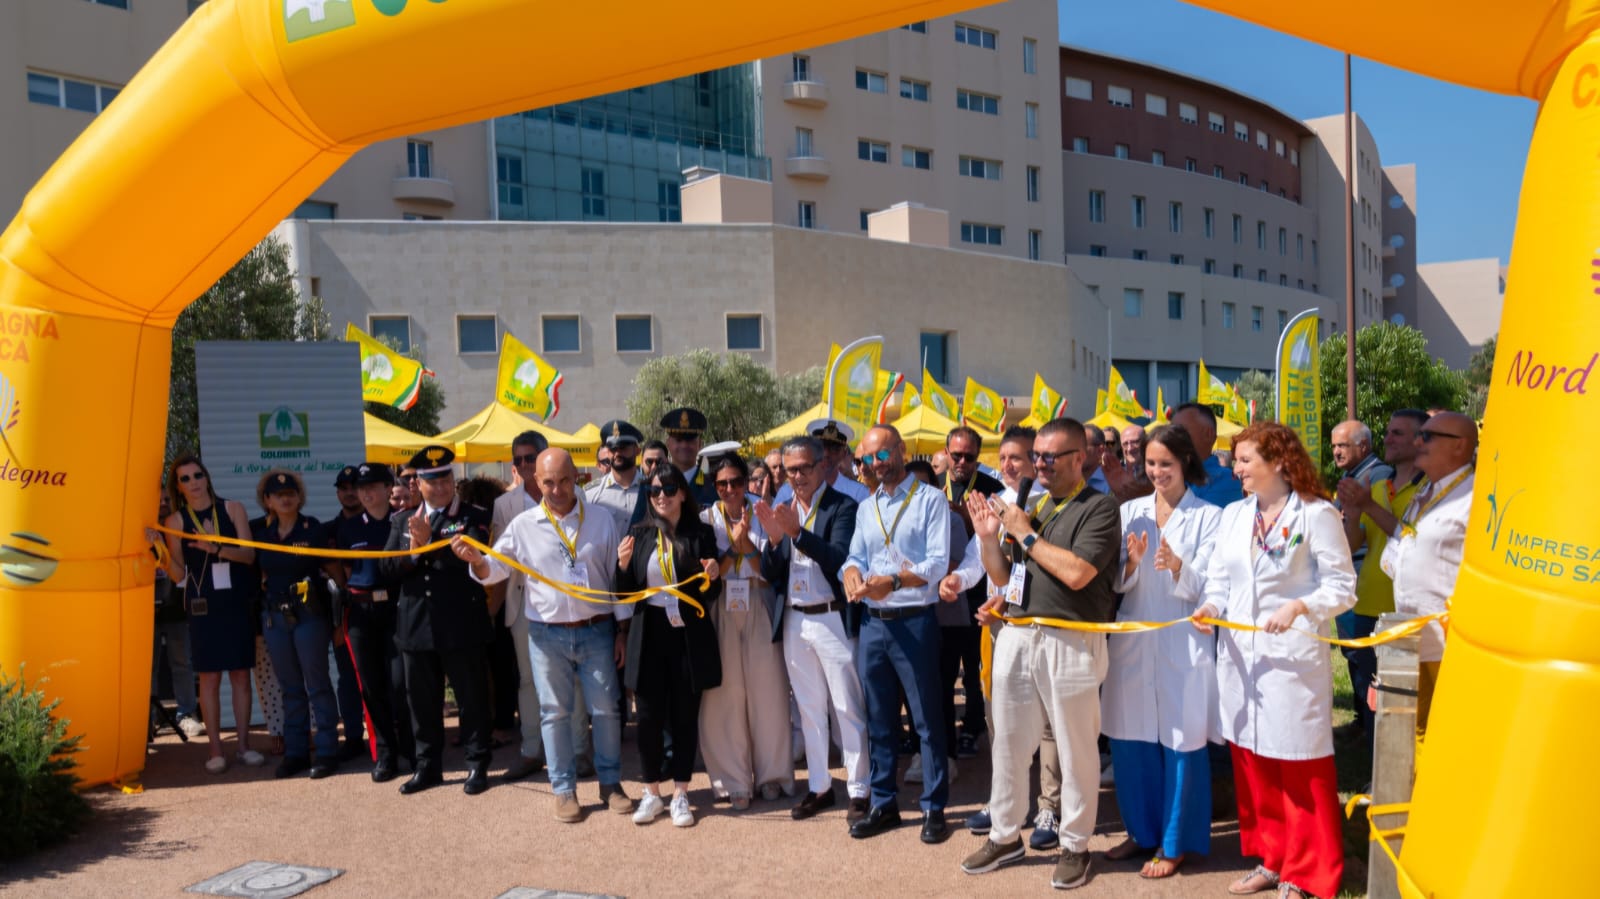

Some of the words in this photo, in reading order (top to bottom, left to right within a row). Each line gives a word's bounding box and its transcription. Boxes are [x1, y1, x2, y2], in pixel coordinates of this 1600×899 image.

[1506, 350, 1600, 395] Nord
[1287, 372, 1302, 436] ETTI
[1303, 374, 1319, 466] ARDEGNA
[1504, 548, 1565, 577] NORD
